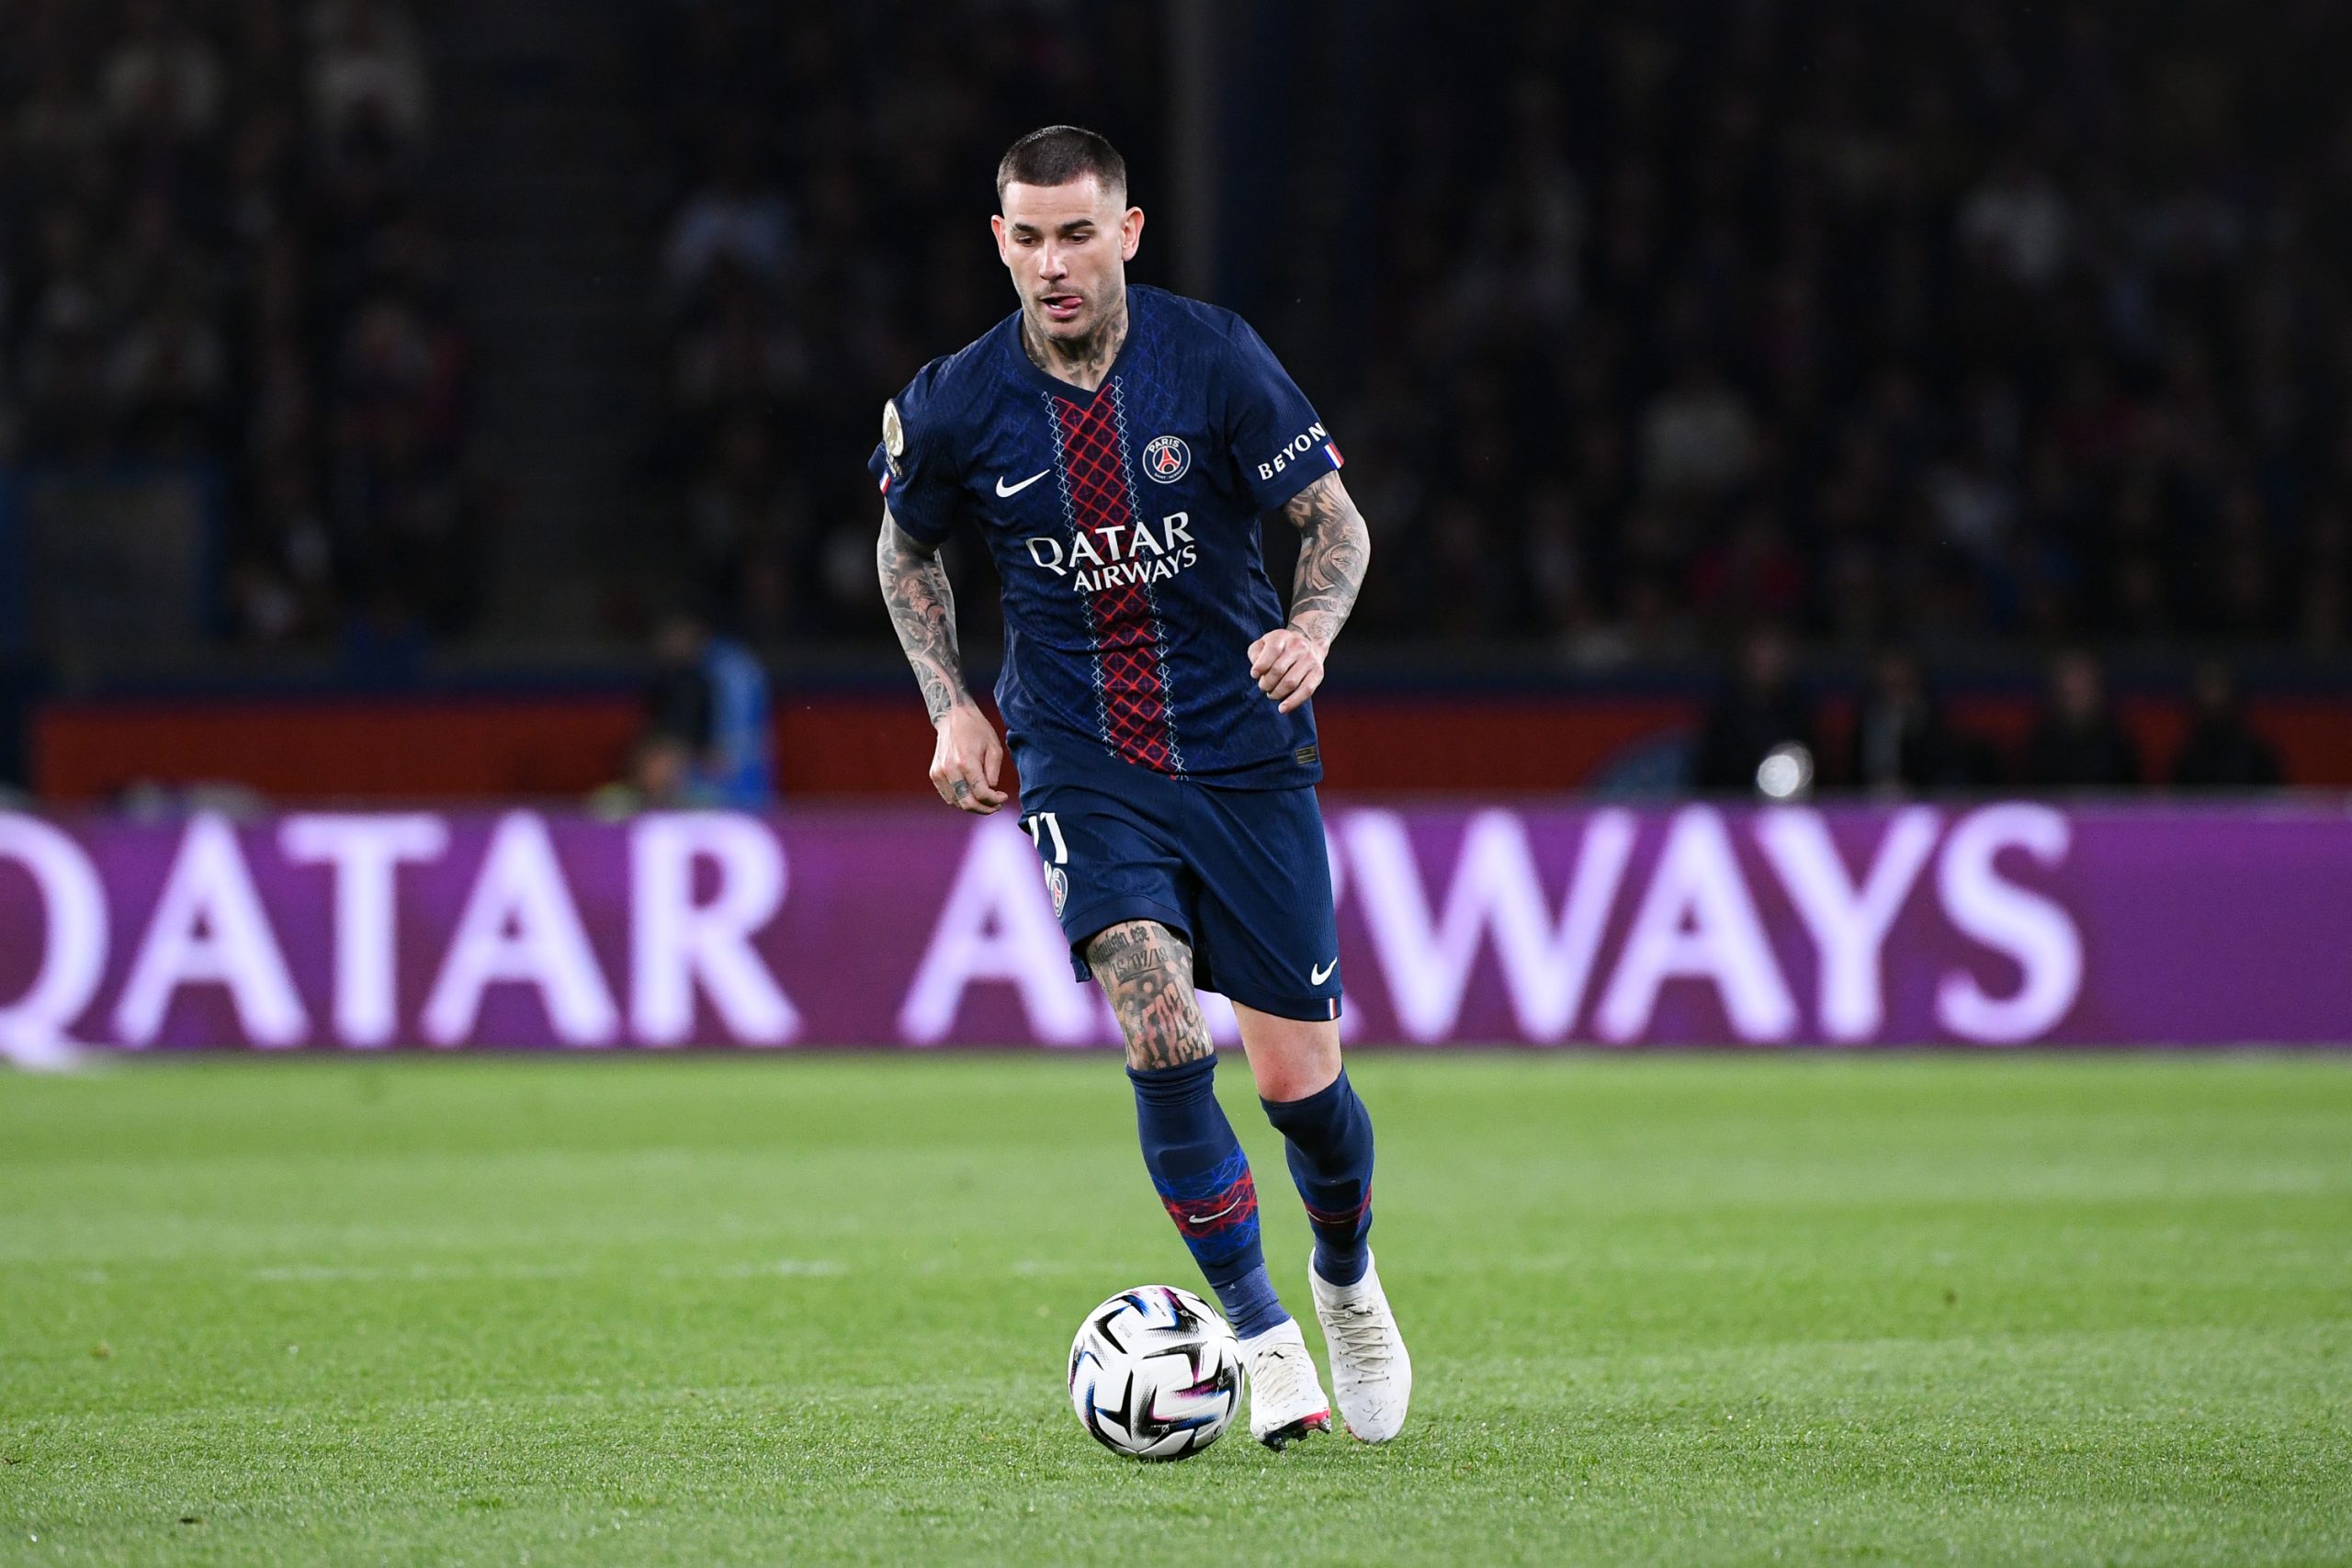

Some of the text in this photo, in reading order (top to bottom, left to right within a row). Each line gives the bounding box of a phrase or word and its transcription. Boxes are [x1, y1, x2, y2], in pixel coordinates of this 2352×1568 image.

[1148, 438, 1181, 453] PARIS
[1025, 512, 1194, 576] QATAR
[1073, 545, 1197, 592] AIRWAYS
[896, 805, 2083, 1045] AWAYS
